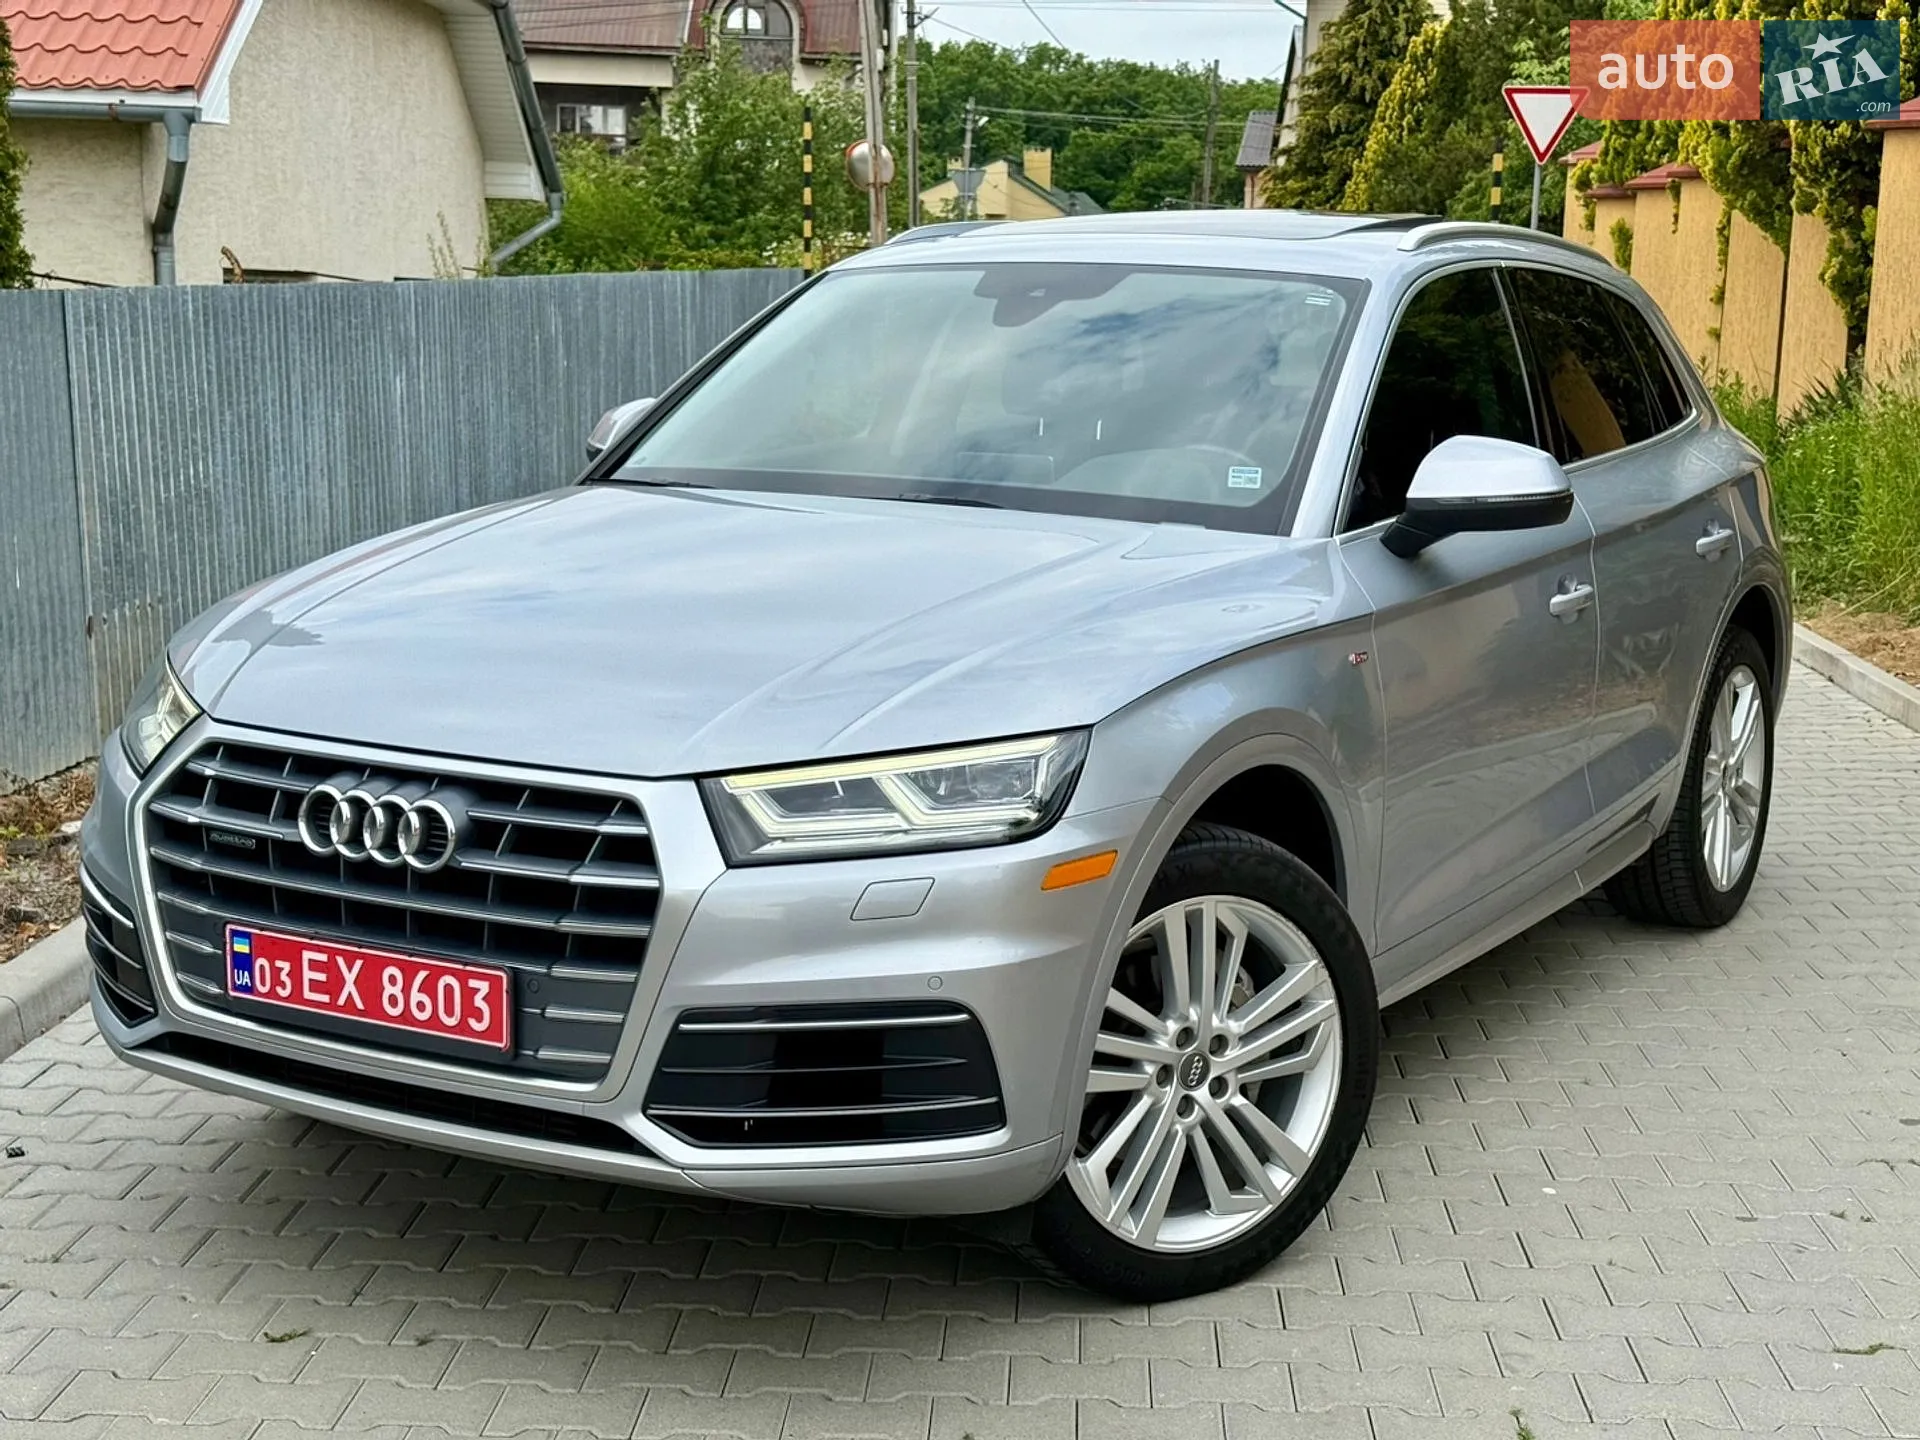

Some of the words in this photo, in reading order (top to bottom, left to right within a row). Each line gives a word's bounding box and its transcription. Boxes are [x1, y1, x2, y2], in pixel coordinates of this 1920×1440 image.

[234, 968, 252, 987] UA
[255, 957, 292, 998] 03
[302, 950, 365, 1011] EX
[382, 966, 491, 1032] 8603
